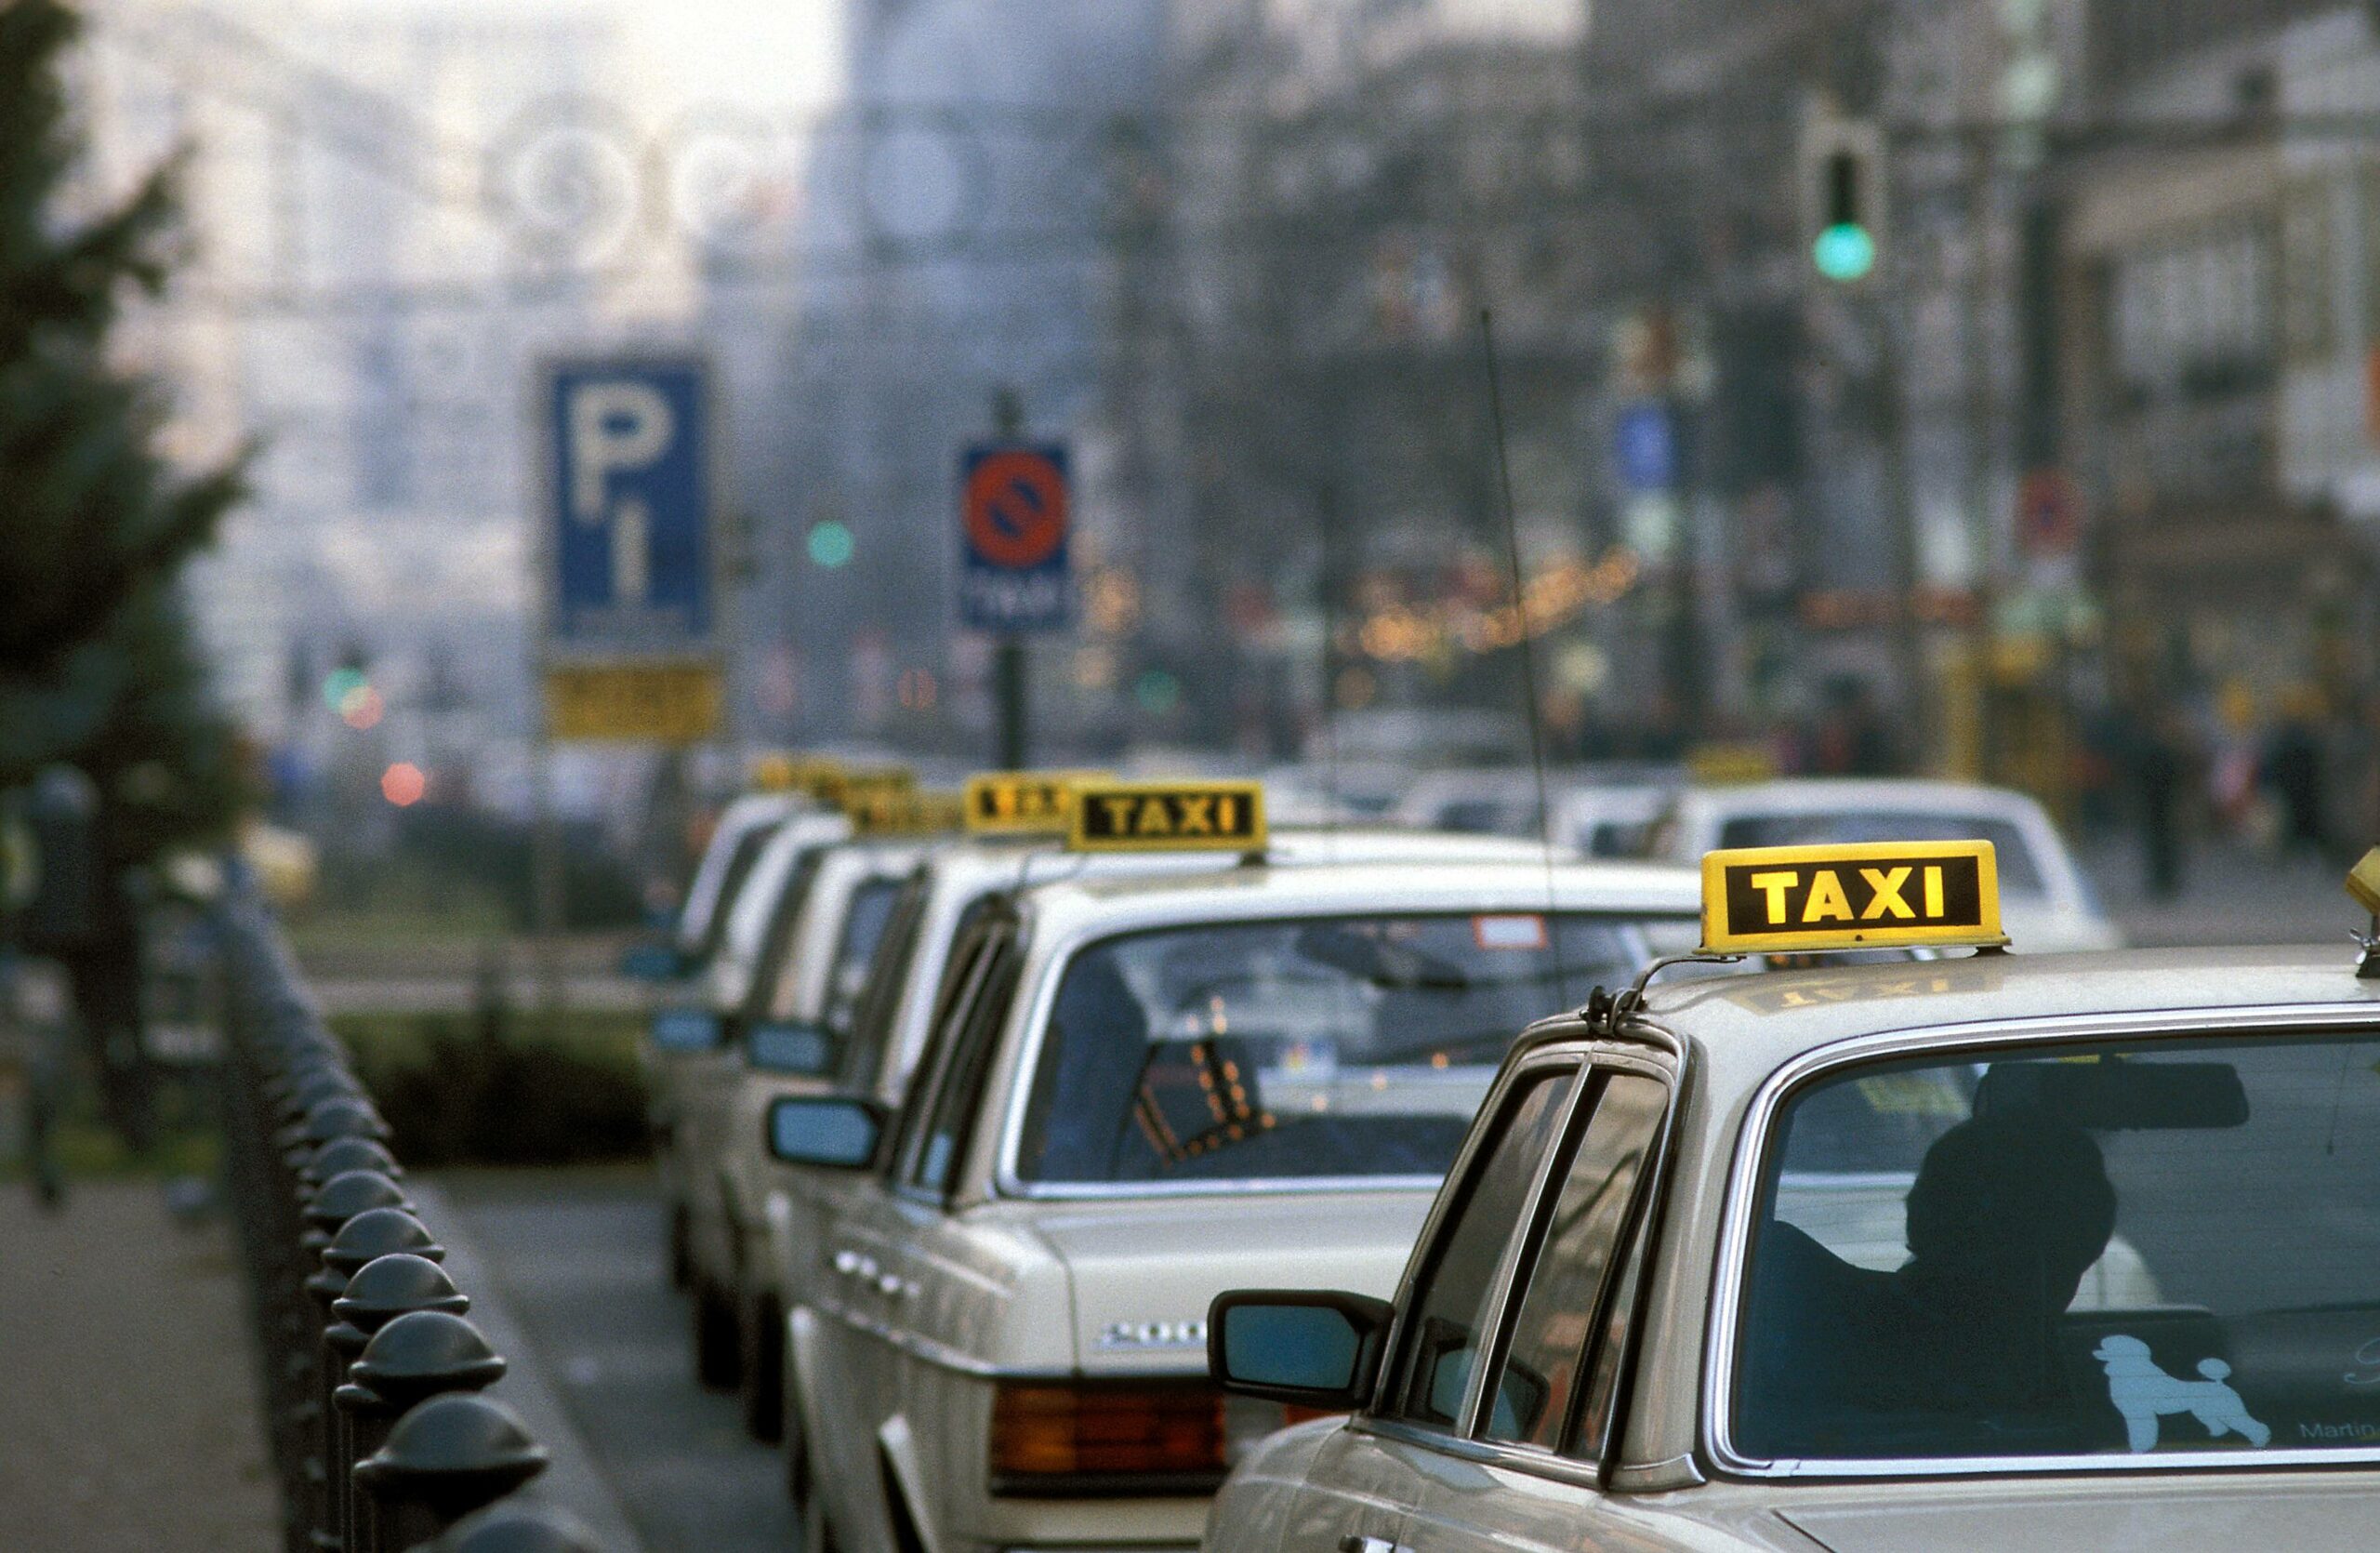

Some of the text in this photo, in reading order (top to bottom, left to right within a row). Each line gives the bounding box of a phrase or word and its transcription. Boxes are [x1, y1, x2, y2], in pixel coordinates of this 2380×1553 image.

[570, 381, 675, 524] P
[1104, 795, 1236, 835] TAXI
[1751, 865, 1946, 925] TAXI
[2299, 1422, 2375, 1438] Martin
